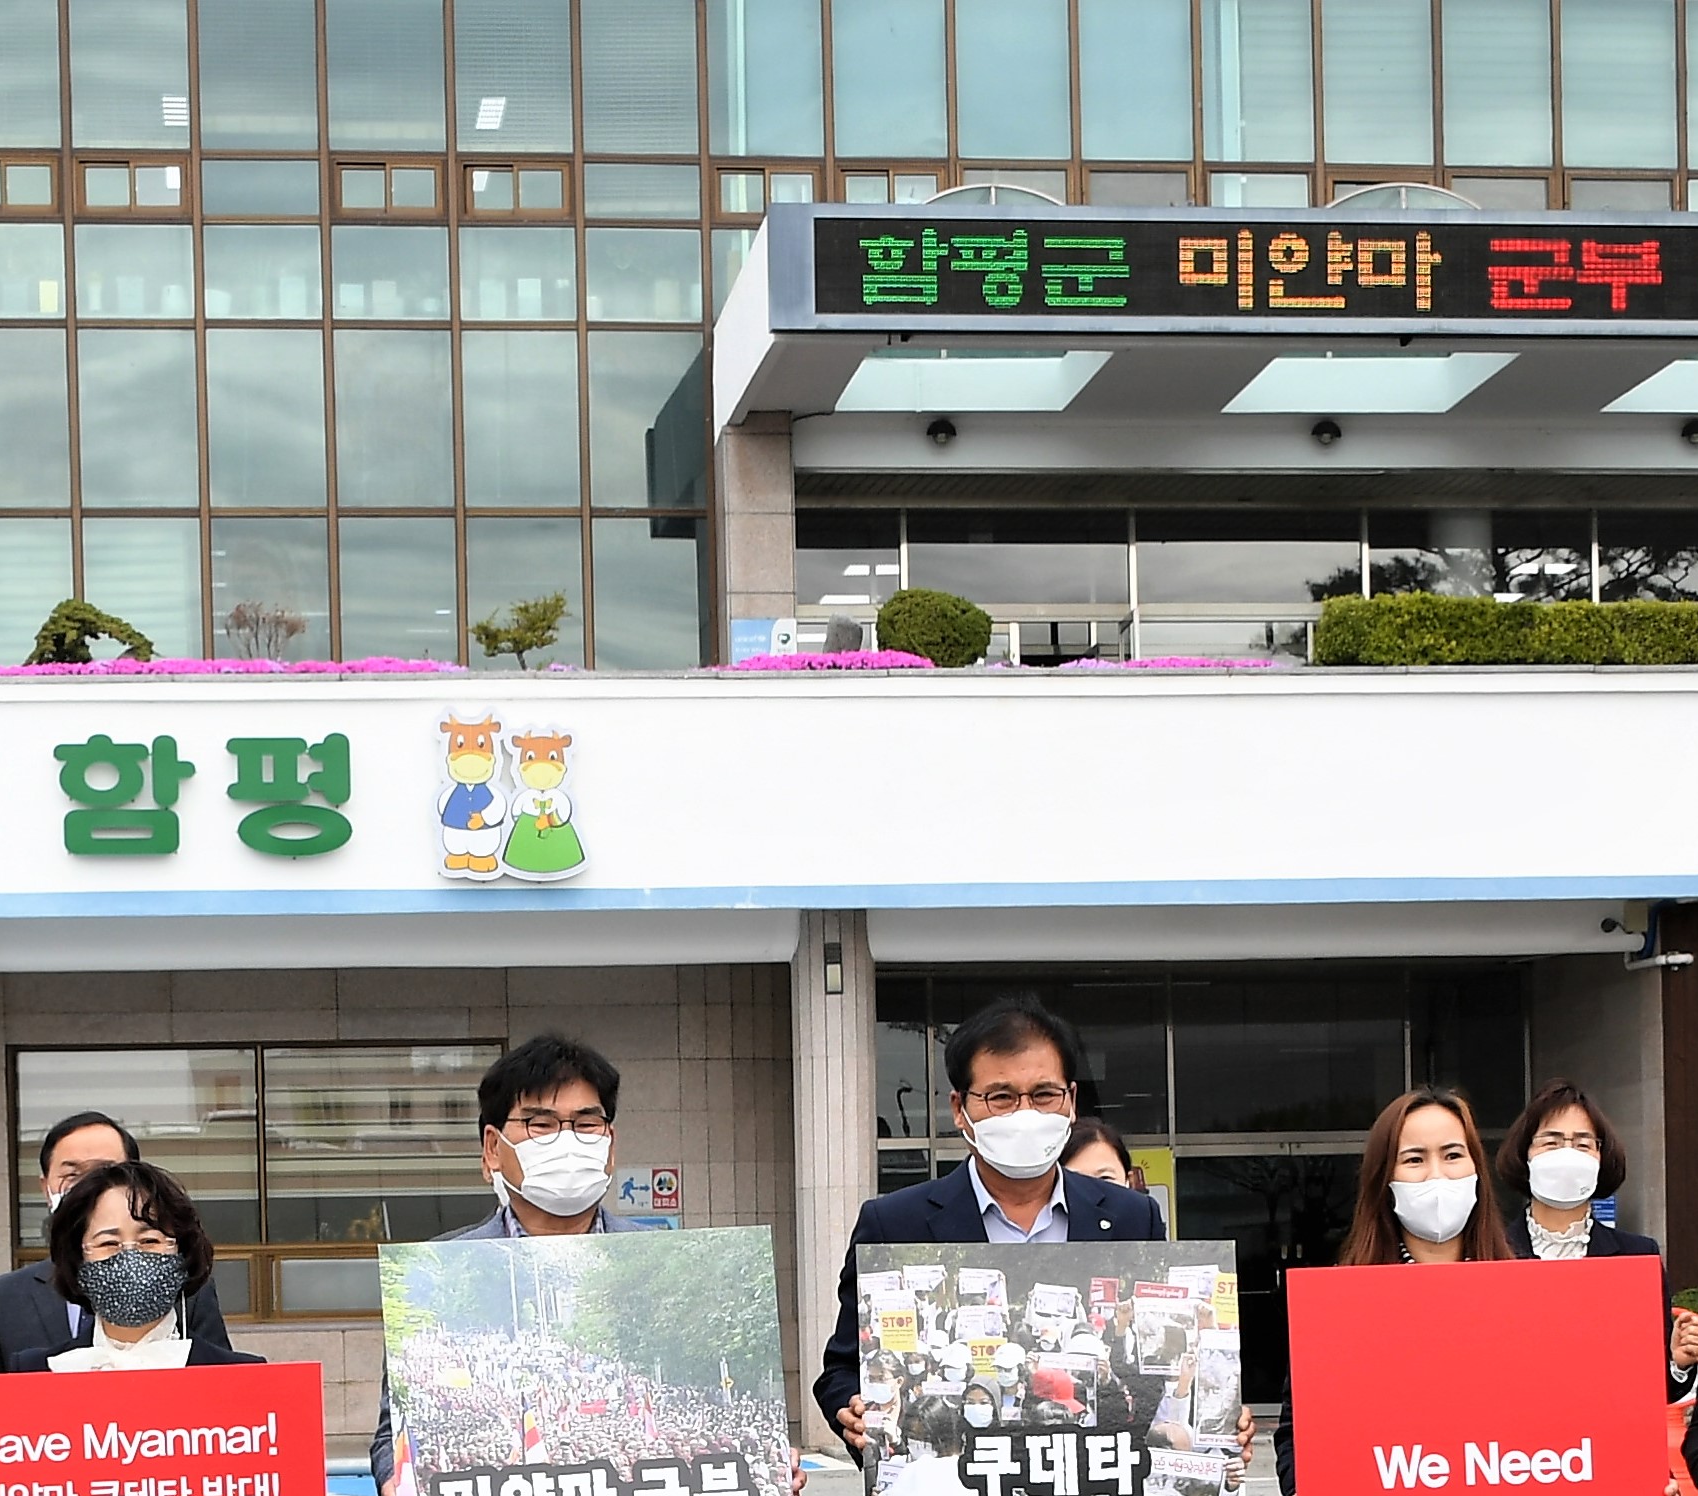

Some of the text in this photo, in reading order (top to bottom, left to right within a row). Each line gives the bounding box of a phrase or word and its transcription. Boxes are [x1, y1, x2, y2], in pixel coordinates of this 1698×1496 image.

[862, 230, 1128, 305] 함평군
[1180, 230, 1441, 308] 미얀마
[1488, 239, 1662, 310] 군부
[56, 735, 352, 857] 함평
[882, 1316, 912, 1328] STOP
[84, 1413, 277, 1464] Myanmar!
[966, 1431, 1140, 1496] 쿠데타
[1374, 1438, 1592, 1488] We Need
